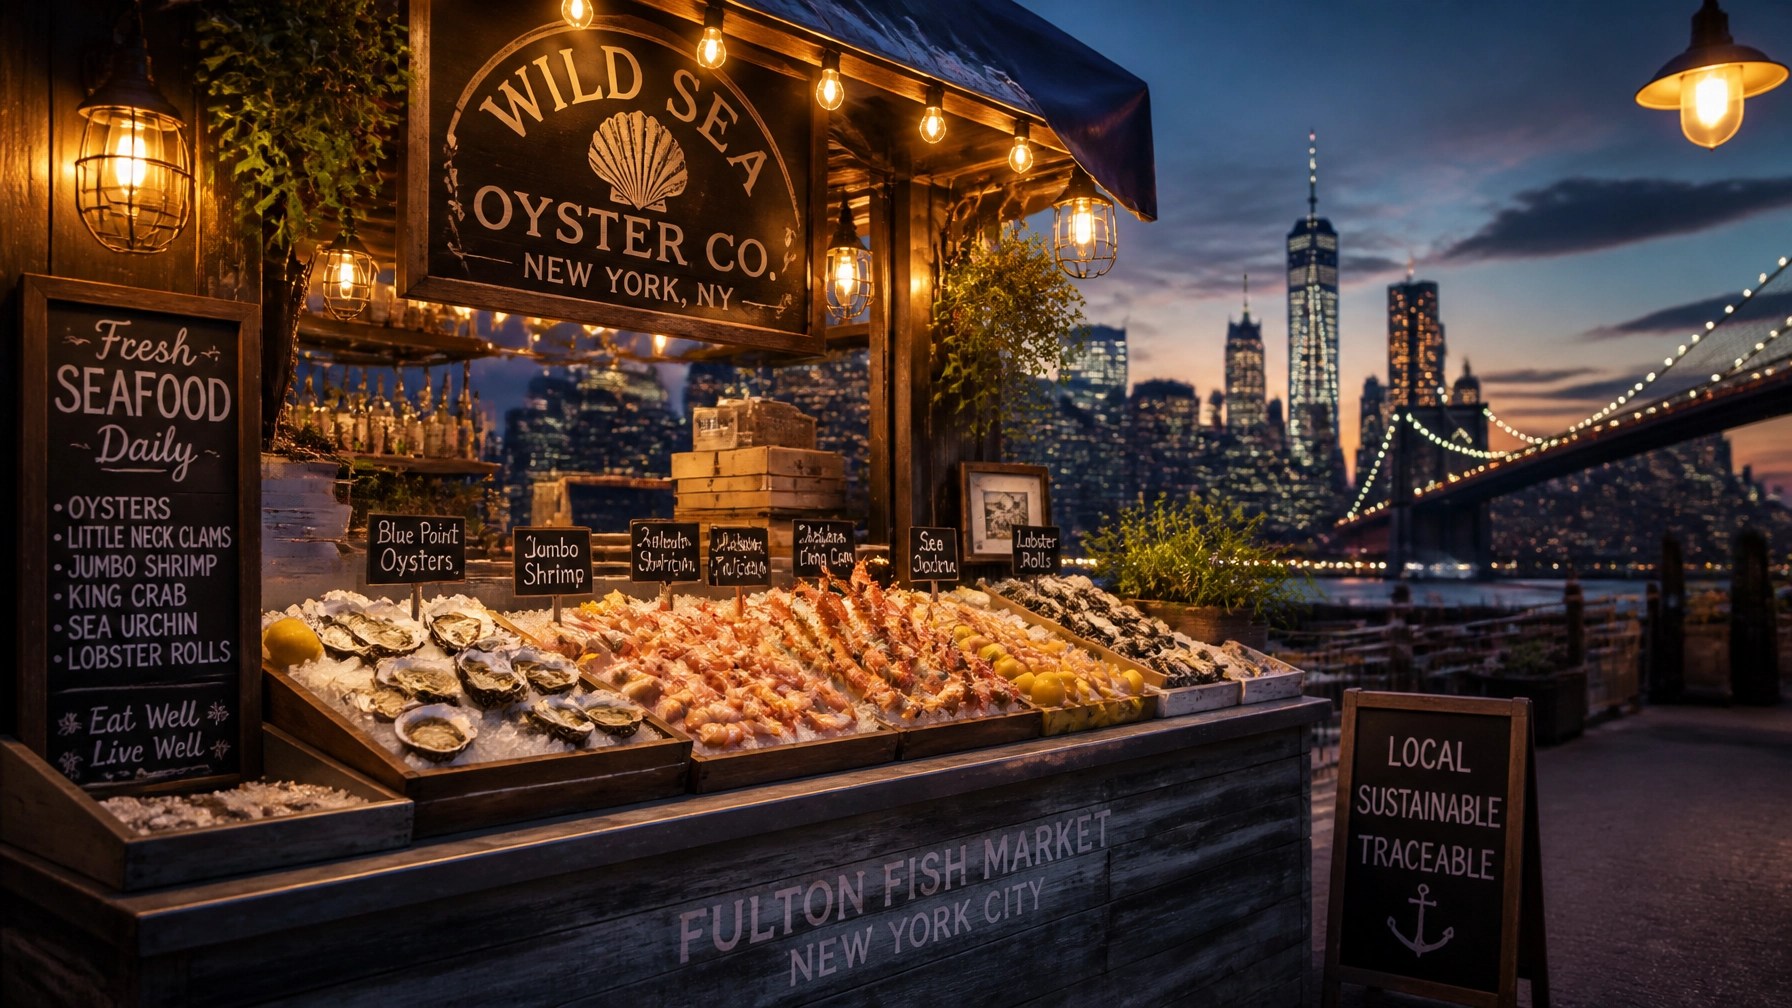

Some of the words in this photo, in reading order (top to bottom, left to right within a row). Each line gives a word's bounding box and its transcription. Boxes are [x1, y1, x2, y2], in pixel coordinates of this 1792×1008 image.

[479, 45, 643, 138] WILD
[666, 69, 768, 197] SEA
[473, 185, 688, 266] OYSTER
[706, 232, 776, 281] CO.
[524, 252, 593, 288] NEW
[605, 266, 688, 309] YORK,
[697, 282, 734, 311] NY
[95, 319, 198, 367] Fresh
[55, 364, 231, 422] SEAFOOD
[95, 424, 198, 482] Daily
[68, 496, 171, 520] OYSTERS
[68, 525, 125, 549] LITTLE
[131, 526, 174, 549] NECK
[179, 525, 232, 549] CLAMS
[377, 519, 414, 545] Blue
[421, 522, 459, 545] Point
[525, 535, 579, 559] Jumbo
[68, 555, 137, 579] JUMBO
[145, 554, 218, 577] SHRIMP
[524, 562, 584, 589] Shrimp
[68, 584, 122, 609] KING
[131, 583, 187, 607] CRAB
[68, 614, 112, 640] SEA
[121, 612, 198, 637] URCHIN
[68, 642, 162, 670] LOBSTER
[171, 640, 232, 664] ROLLS
[89, 705, 136, 735] Eat
[145, 700, 200, 730] Well
[90, 740, 144, 767] Live
[153, 731, 205, 759] Well
[1388, 736, 1471, 773] LOCAL
[1357, 785, 1502, 828] SUSTAINABLE
[1358, 834, 1495, 880] TRACEABLE
[679, 870, 866, 964] FULTON
[884, 844, 967, 906] FISH
[983, 809, 1111, 880] MARKET
[789, 925, 873, 987] NEW
[888, 898, 972, 955] YORK
[984, 877, 1045, 925] CITY
